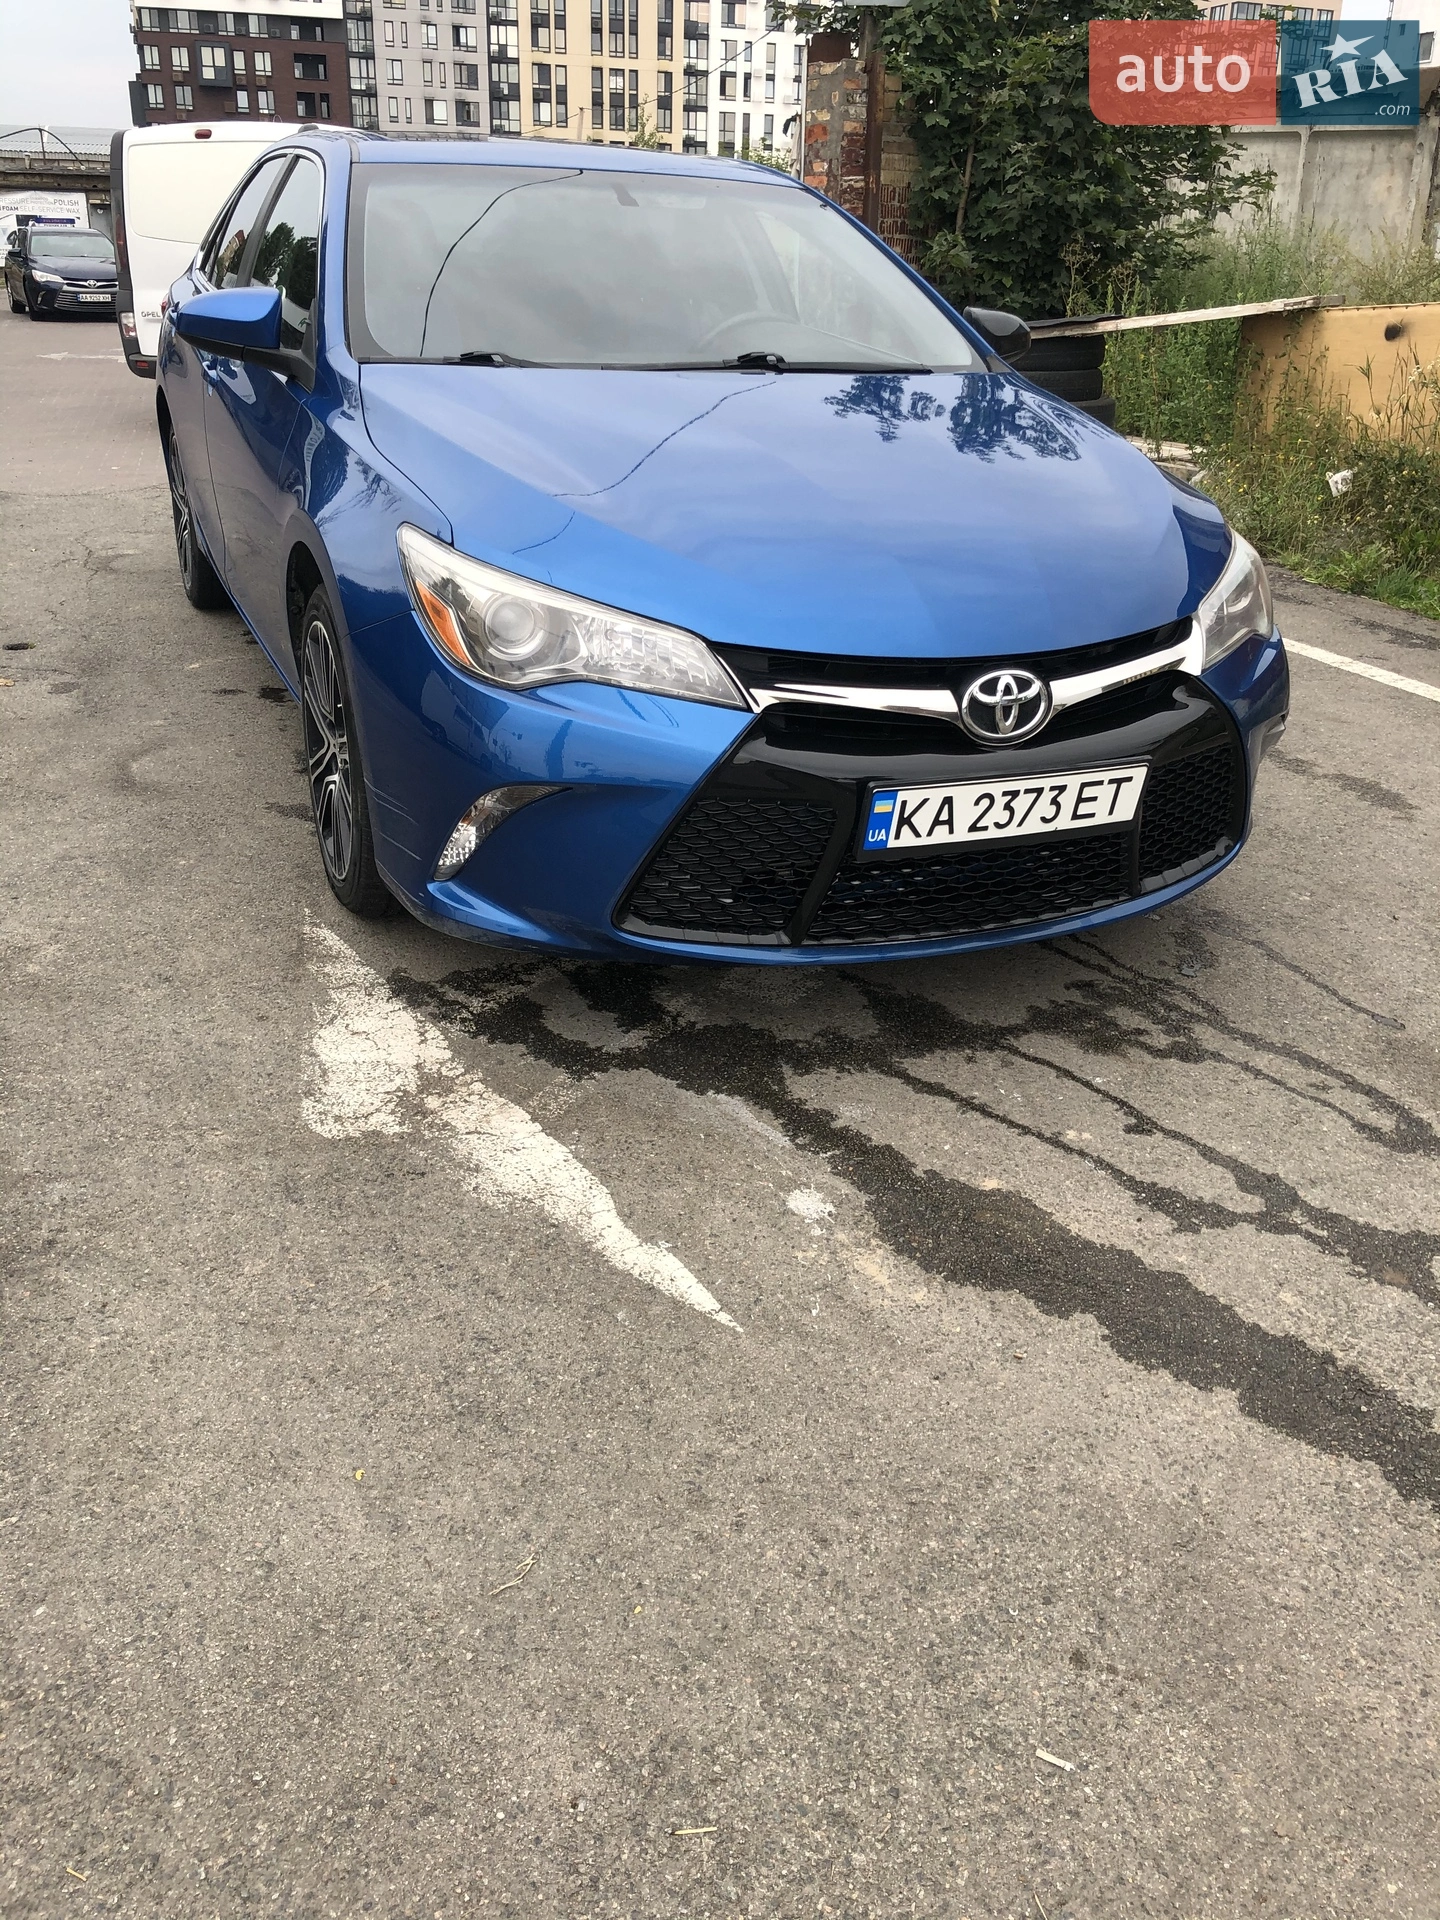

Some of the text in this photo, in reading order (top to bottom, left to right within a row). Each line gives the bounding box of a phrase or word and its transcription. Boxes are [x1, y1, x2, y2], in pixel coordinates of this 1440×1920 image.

[53, 198, 80, 206] POLISH
[893, 775, 1134, 841] KA 2373 ET
[868, 827, 887, 842] UA
